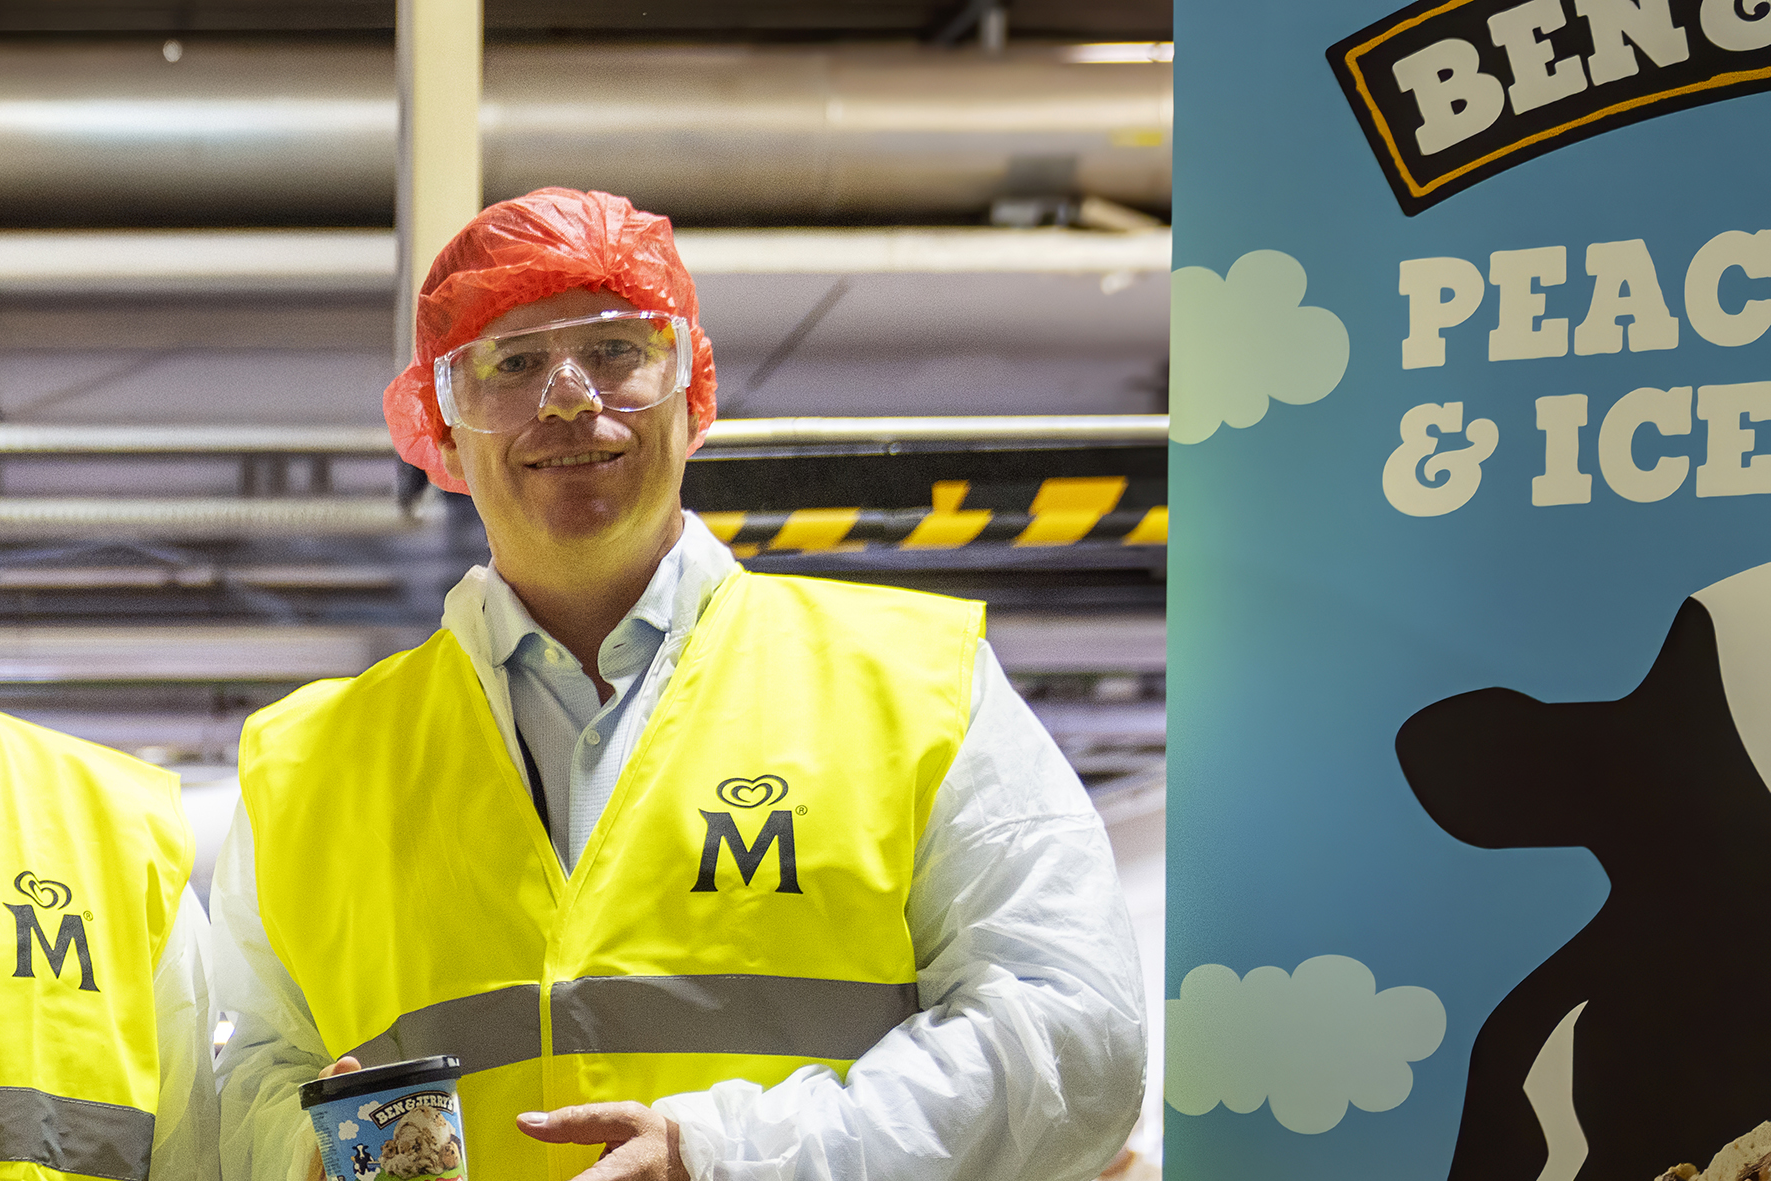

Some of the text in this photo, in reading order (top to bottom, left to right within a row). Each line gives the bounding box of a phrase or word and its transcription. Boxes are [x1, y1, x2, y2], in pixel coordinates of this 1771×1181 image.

[1398, 229, 1771, 370] PEAC
[1382, 381, 1771, 517] & ICE
